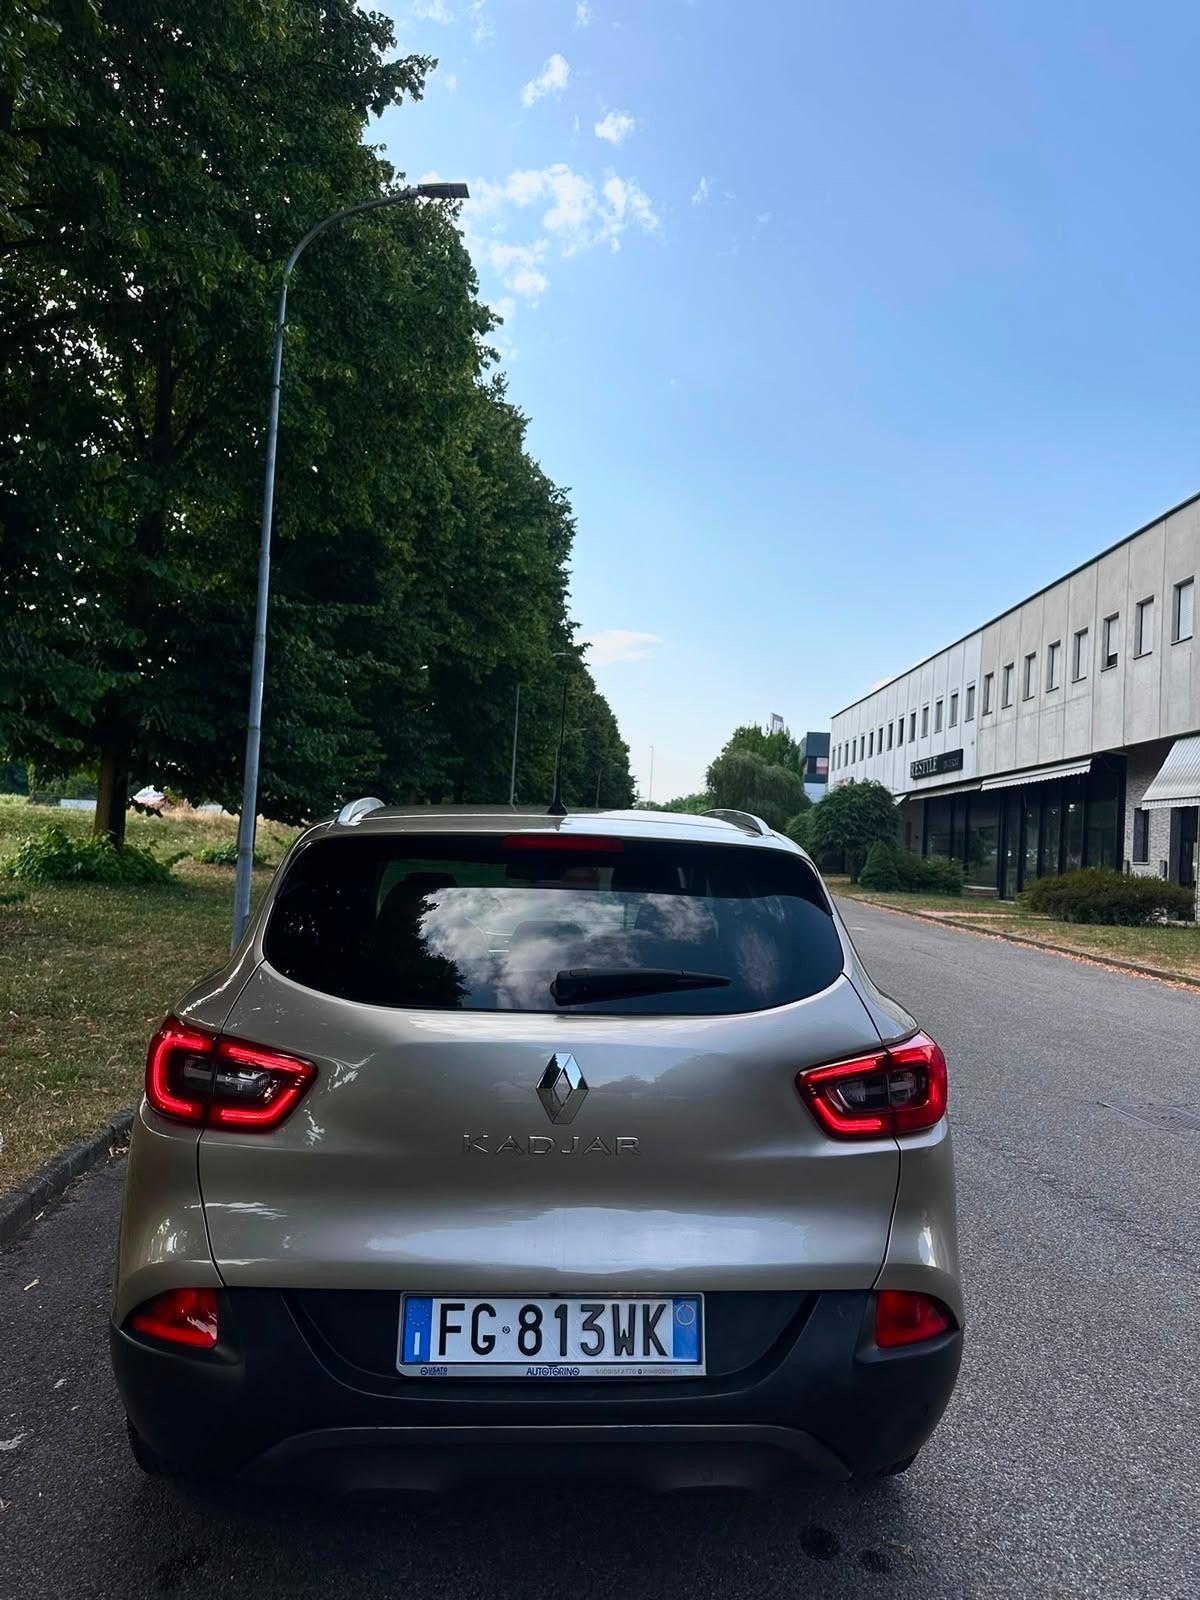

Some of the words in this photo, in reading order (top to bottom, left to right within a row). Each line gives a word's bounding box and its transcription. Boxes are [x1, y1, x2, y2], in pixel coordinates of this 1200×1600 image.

[462, 1134, 641, 1155] KADJAR
[438, 1303, 496, 1356] FG
[518, 1303, 668, 1357] 813WK
[526, 1367, 580, 1377] AUTOTORINO
